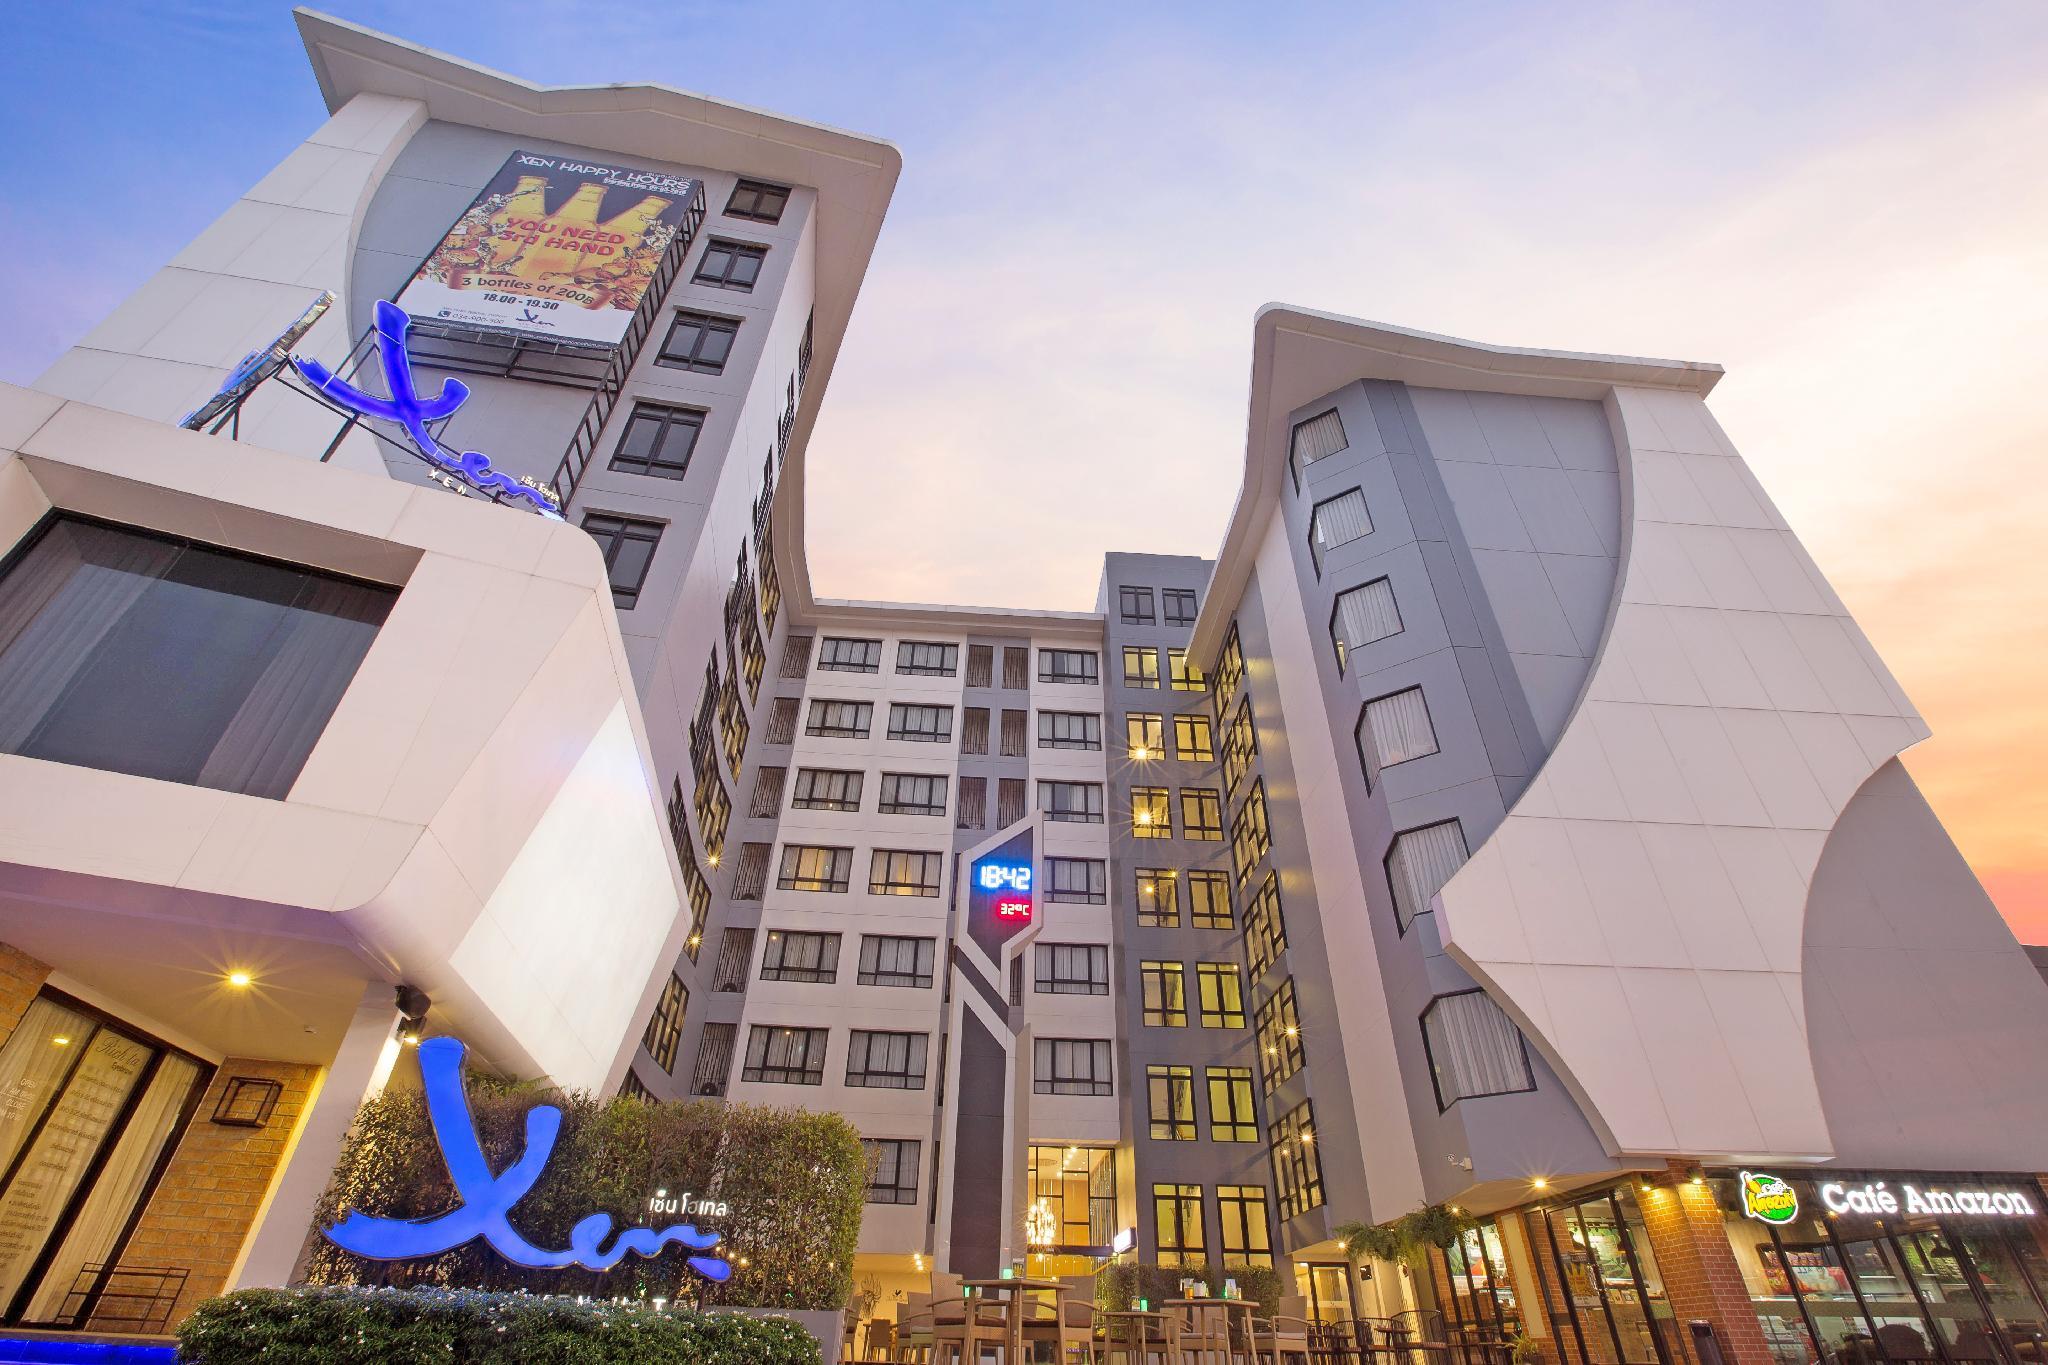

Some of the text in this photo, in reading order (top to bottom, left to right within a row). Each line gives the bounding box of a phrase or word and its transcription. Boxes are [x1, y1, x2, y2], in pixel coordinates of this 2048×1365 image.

[516, 154, 555, 168] XEN
[559, 162, 622, 180] HAPPY
[627, 172, 692, 190] HOURS
[507, 217, 626, 244] YOU NEED
[544, 237, 615, 256] HAND
[461, 277, 472, 286] 3
[477, 277, 534, 291] bottles
[536, 285, 555, 293] of
[483, 293, 517, 304] 18.00
[526, 299, 560, 311] 19.30
[428, 469, 468, 495] XEN
[980, 865, 1032, 890] 18:42
[320, 1035, 732, 1282] Xen
[1822, 1181, 2036, 1216] Café Amazon
